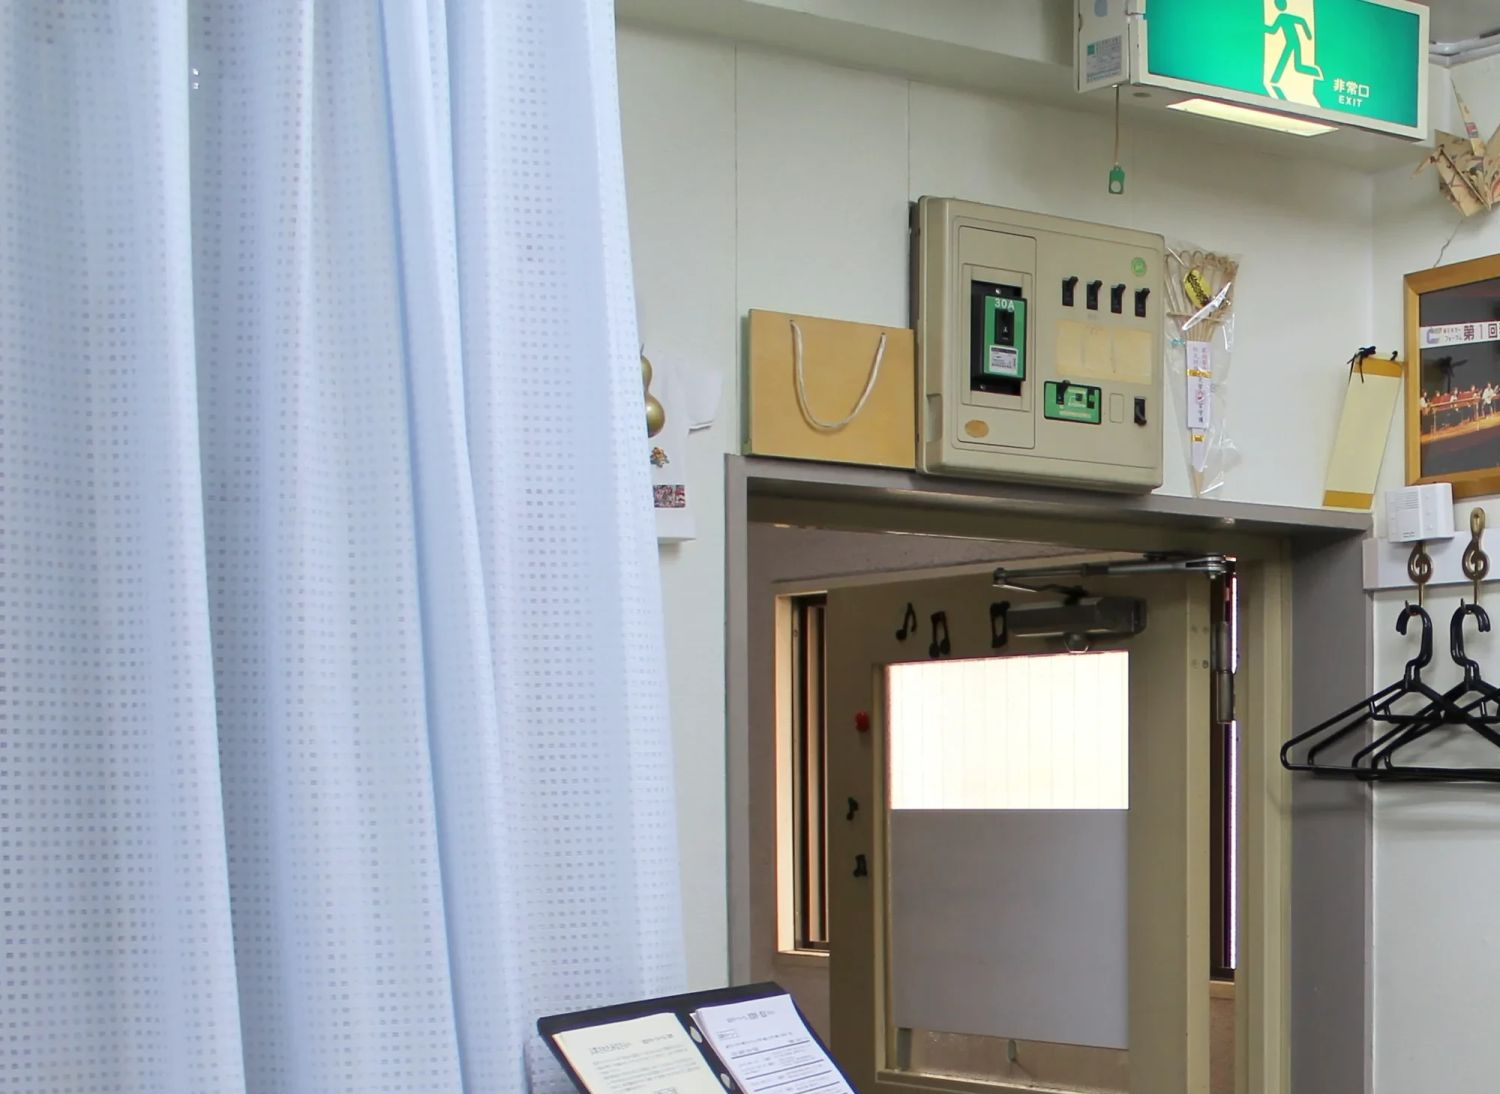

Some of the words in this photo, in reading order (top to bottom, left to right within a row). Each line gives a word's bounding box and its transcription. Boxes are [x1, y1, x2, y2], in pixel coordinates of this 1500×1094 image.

[1333, 79, 1370, 98] 非常口
[1339, 96, 1362, 108] EXIT
[993, 297, 1015, 310] 30A
